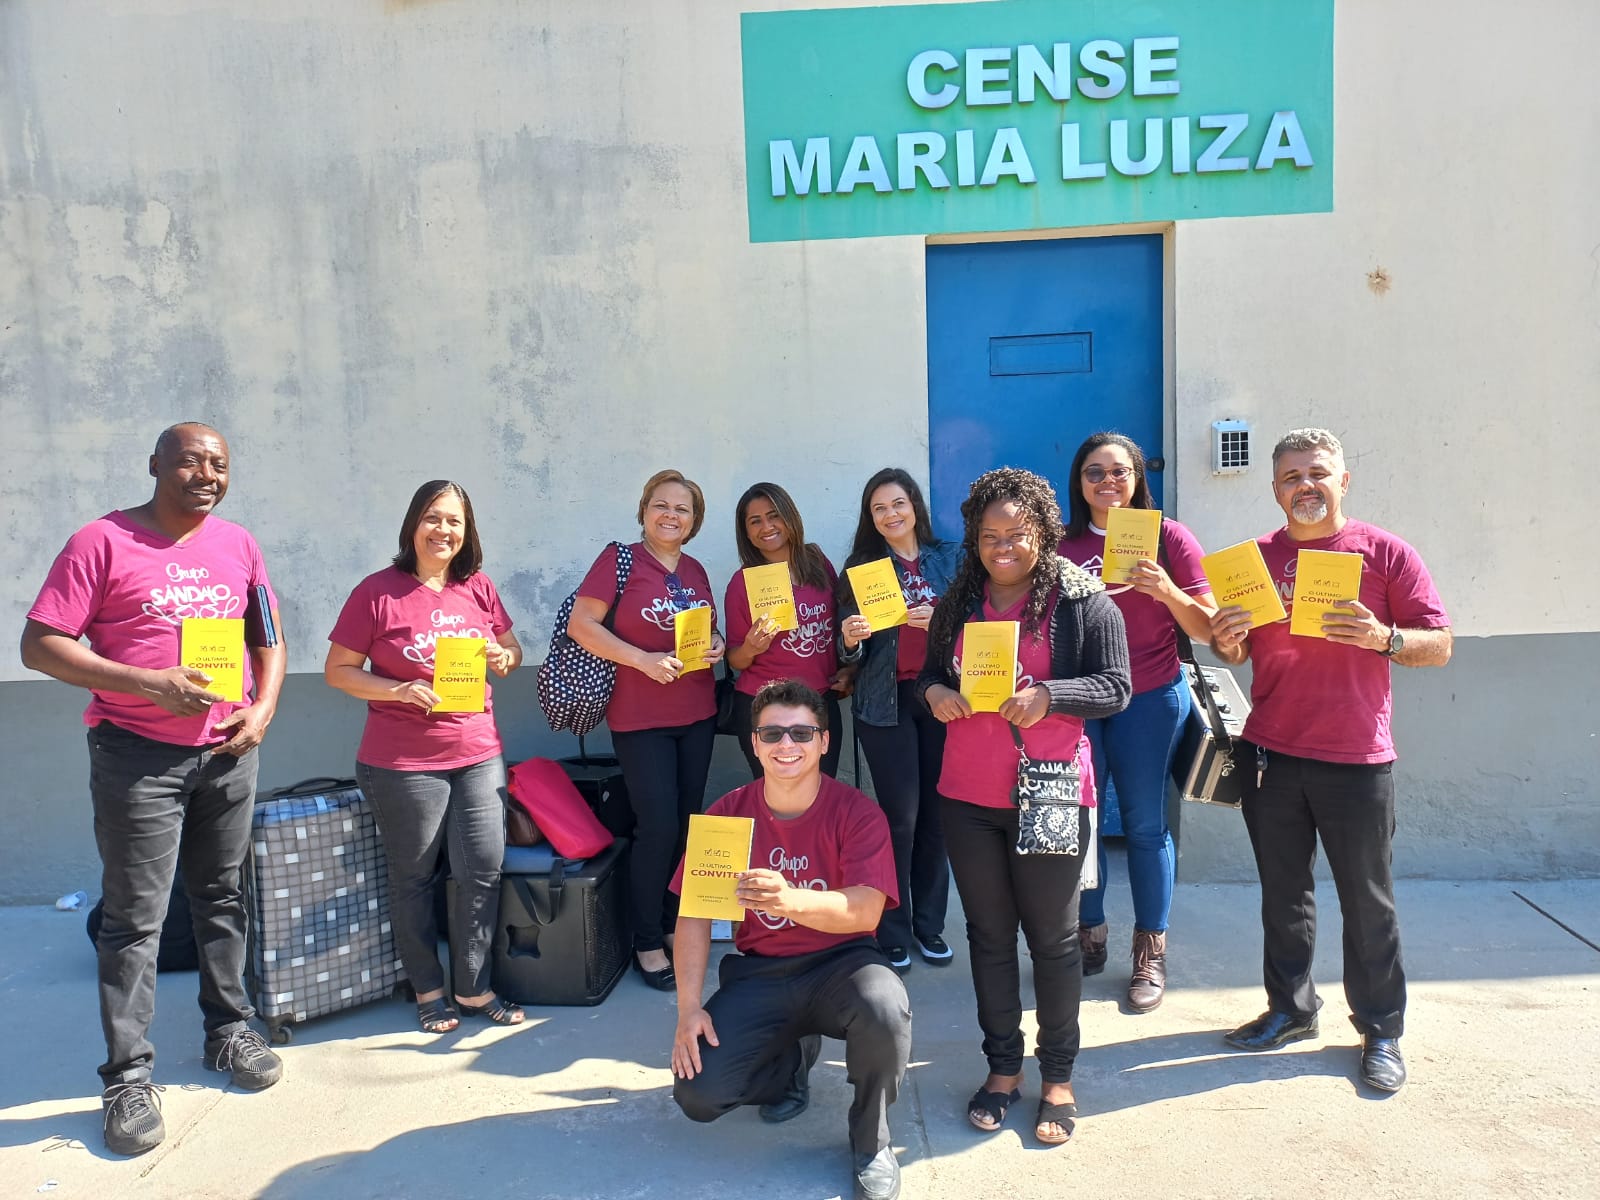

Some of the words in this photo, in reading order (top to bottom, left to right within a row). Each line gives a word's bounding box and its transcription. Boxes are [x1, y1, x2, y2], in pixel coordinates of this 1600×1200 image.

[906, 36, 1181, 109] CENSE
[768, 127, 1038, 197] MARIA
[1061, 110, 1315, 181] LUIZA
[1109, 548, 1151, 556] CONVITE
[165, 562, 209, 584] Grupo
[863, 592, 898, 606] CONVITE
[1222, 583, 1267, 602] CONVITE
[1300, 595, 1336, 605] CONVI
[754, 598, 789, 609] CONVITE
[799, 602, 827, 621] Grupo
[430, 609, 465, 628] Grupo
[769, 846, 809, 878] Grupo
[690, 869, 739, 879] CONVITE
